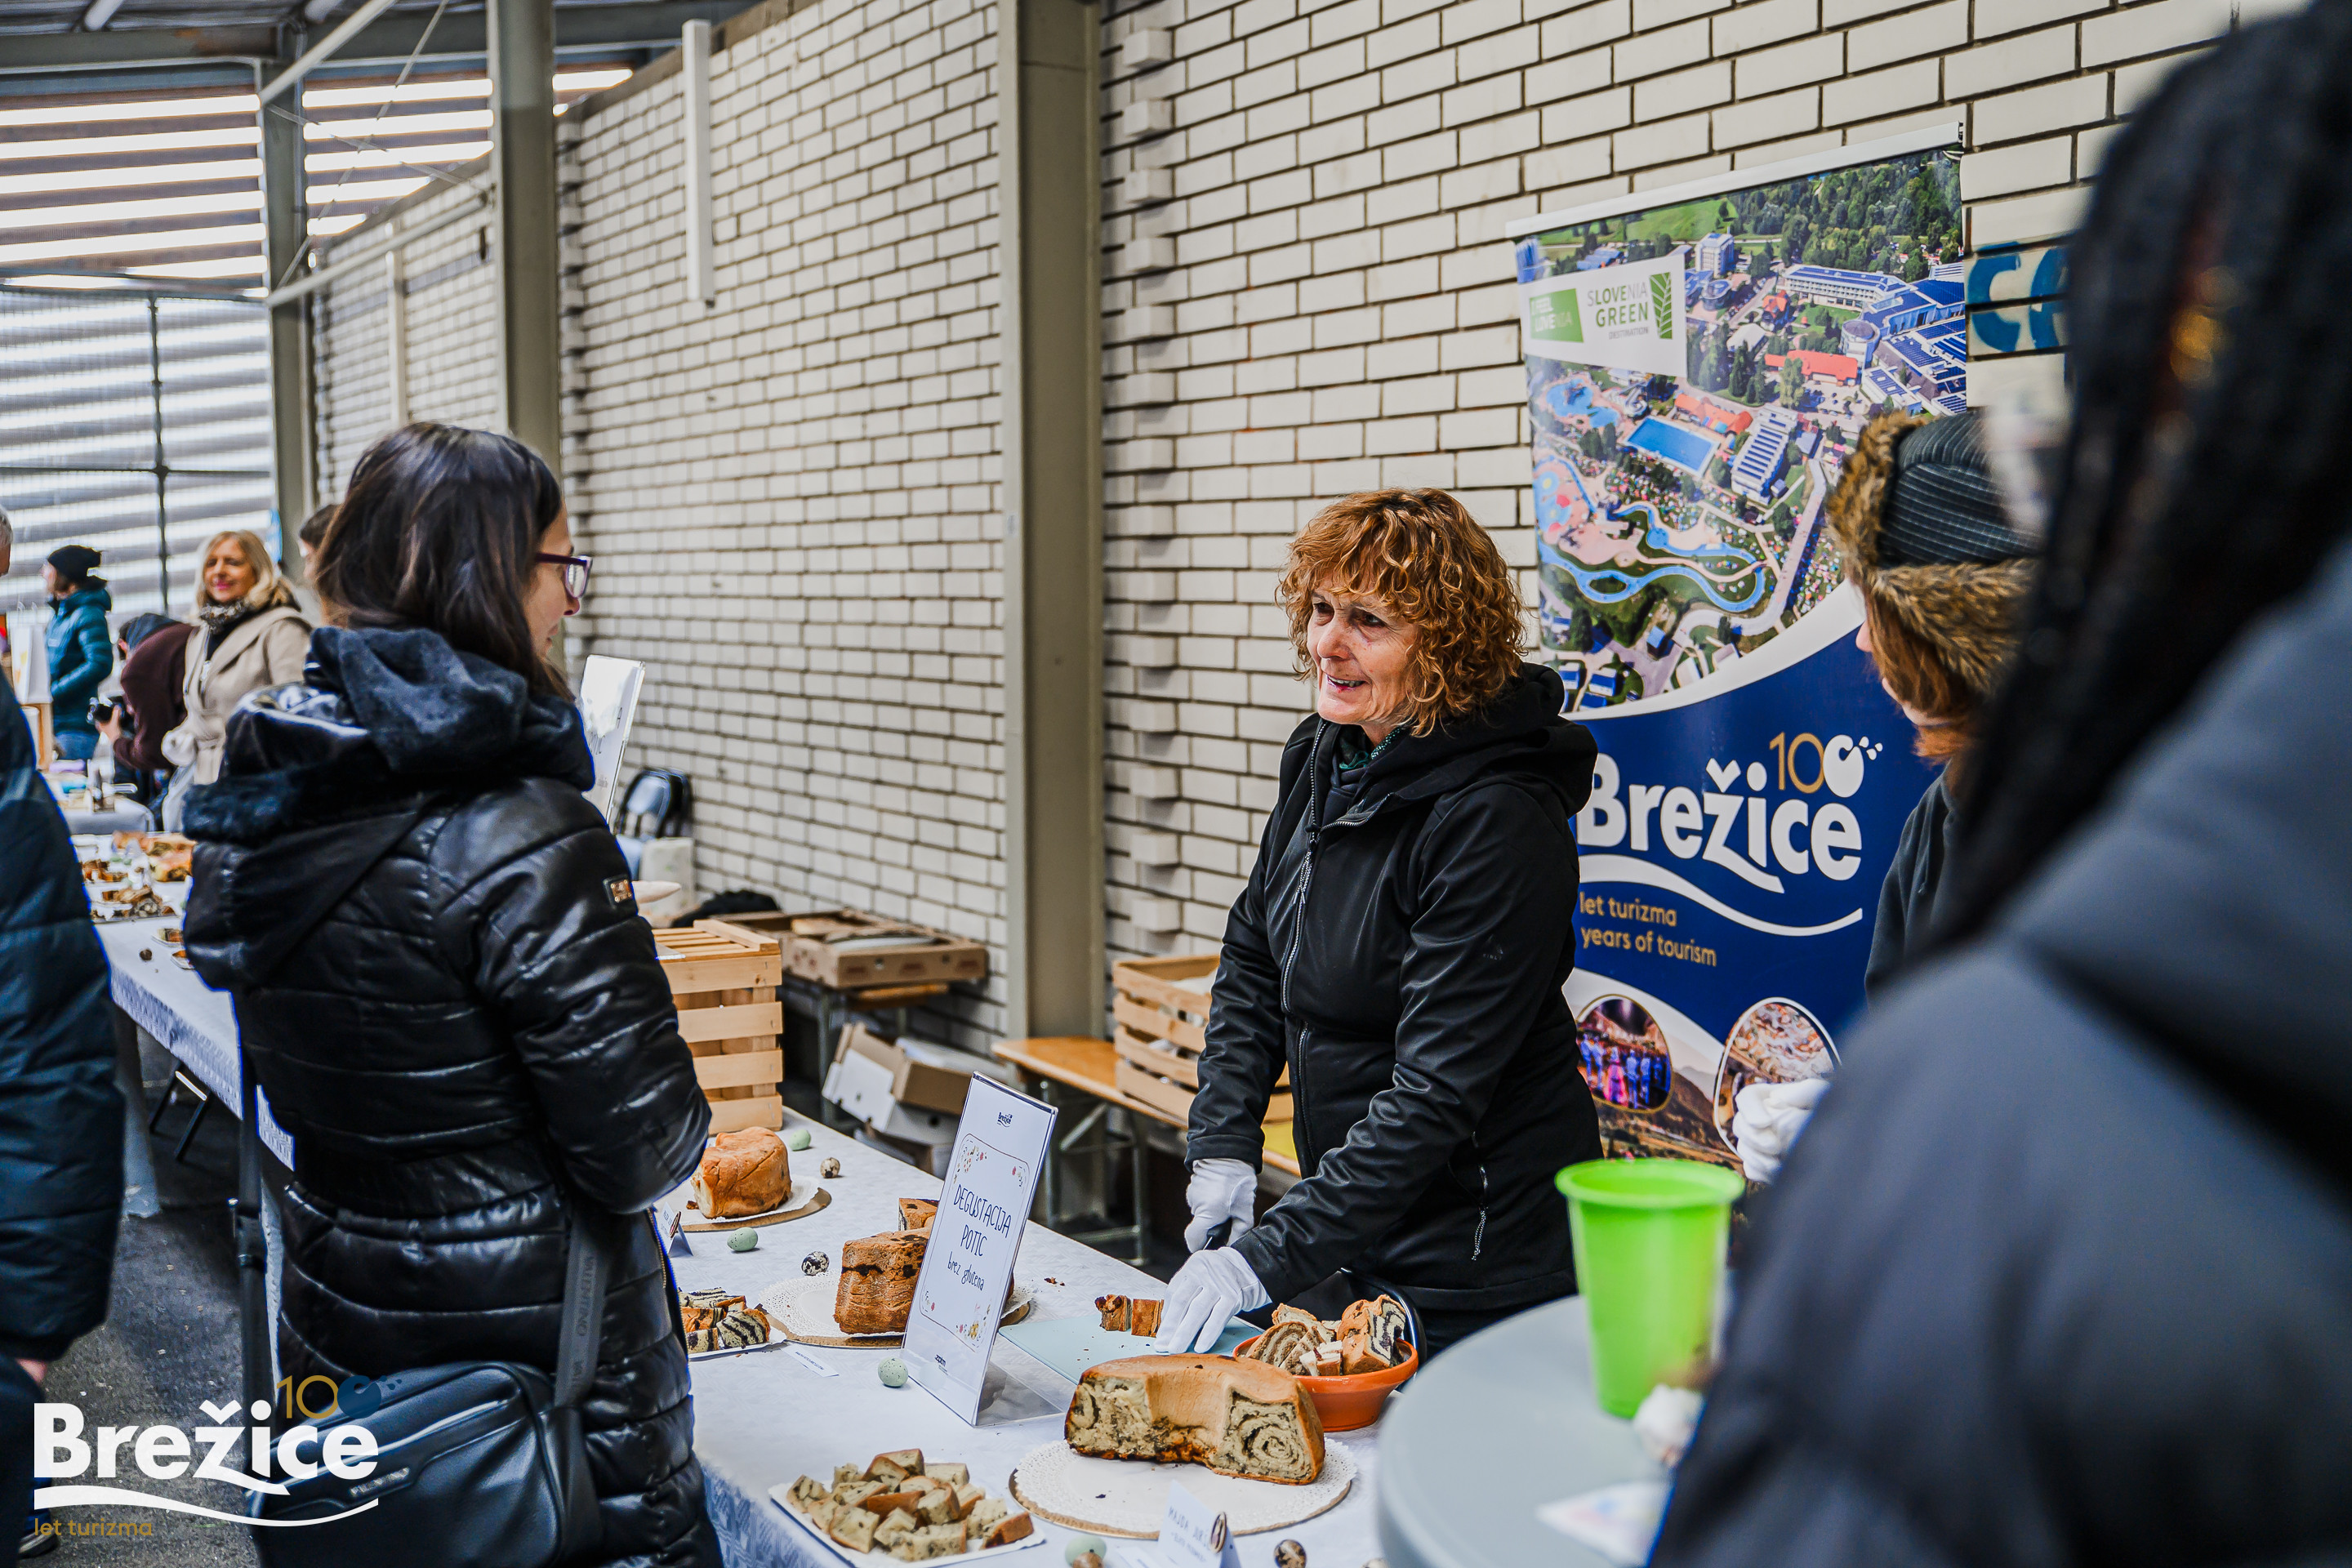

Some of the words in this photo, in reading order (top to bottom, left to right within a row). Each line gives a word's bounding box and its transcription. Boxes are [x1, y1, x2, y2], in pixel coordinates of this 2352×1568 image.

[1587, 282, 1648, 307] SLOVENIA
[1596, 301, 1648, 328] GREEN
[1608, 327, 1648, 340] DESTINATION
[1576, 753, 1862, 893] Brežice
[1579, 891, 1605, 916] let
[1608, 897, 1677, 927] turizma
[1581, 926, 1632, 949] years
[1635, 930, 1654, 953] of
[1657, 934, 1717, 967] tourism
[954, 1184, 1012, 1238] DEGUSTACIJA
[960, 1224, 987, 1256] POTIC
[947, 1251, 961, 1276] brez
[961, 1264, 985, 1291] glutena
